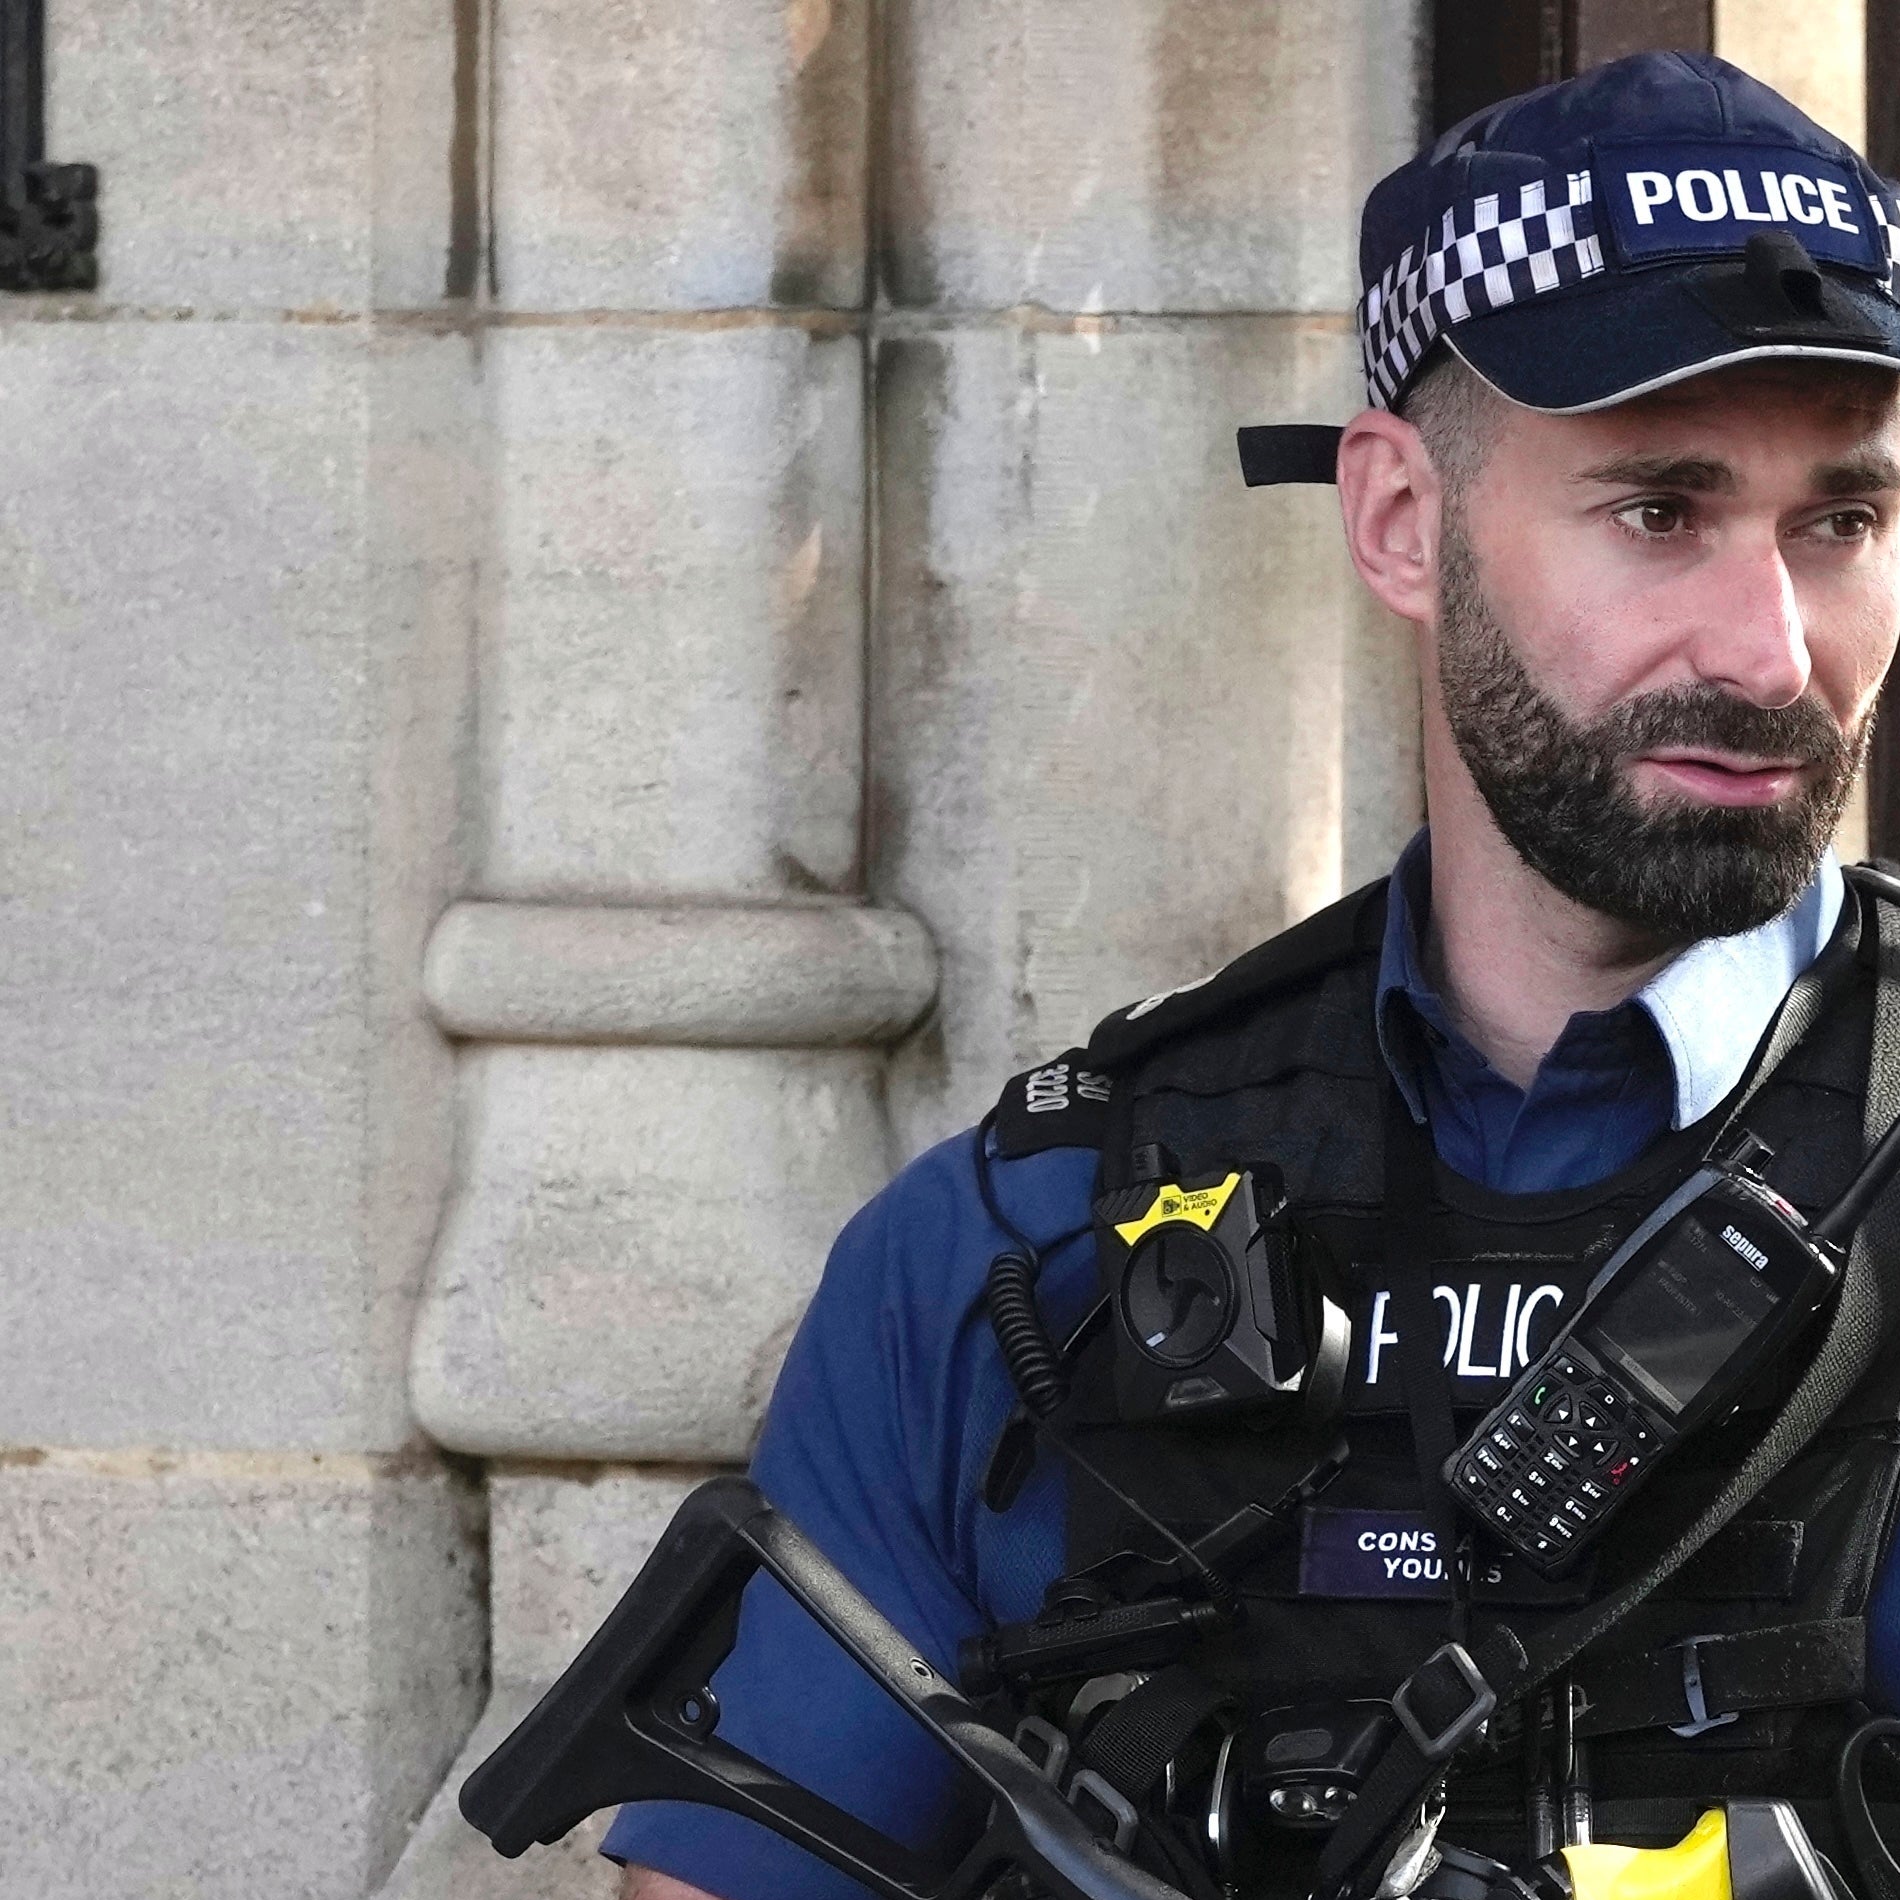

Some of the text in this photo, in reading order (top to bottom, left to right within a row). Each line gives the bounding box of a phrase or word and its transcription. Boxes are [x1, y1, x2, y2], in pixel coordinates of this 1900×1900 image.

[1626, 169, 1860, 235] POLICE
[1183, 1192, 1208, 1203] VIDEO
[1191, 1199, 1217, 1211] AUDIO
[1721, 1224, 1769, 1270] sepura
